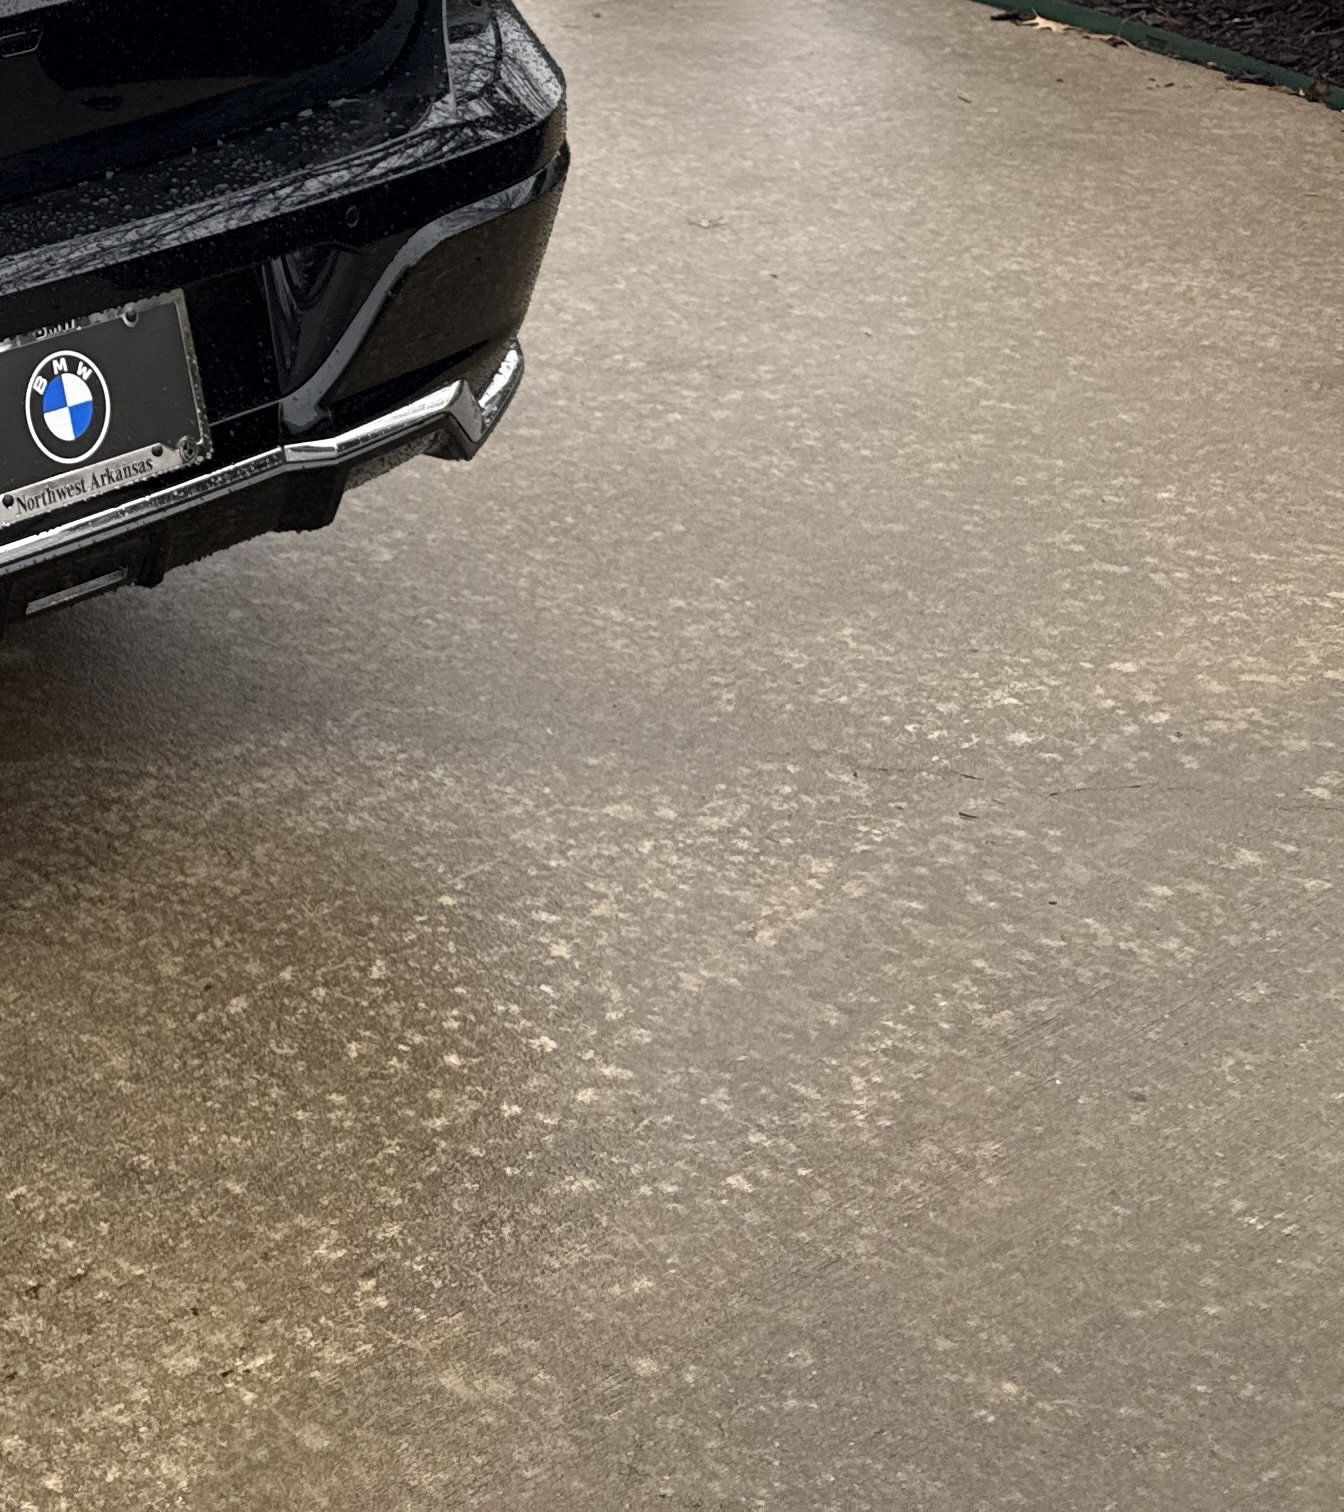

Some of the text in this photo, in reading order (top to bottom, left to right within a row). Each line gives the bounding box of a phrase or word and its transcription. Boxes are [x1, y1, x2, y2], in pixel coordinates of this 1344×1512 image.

[32, 357, 93, 396] BMW
[15, 456, 154, 516] Northwest Arkansas
